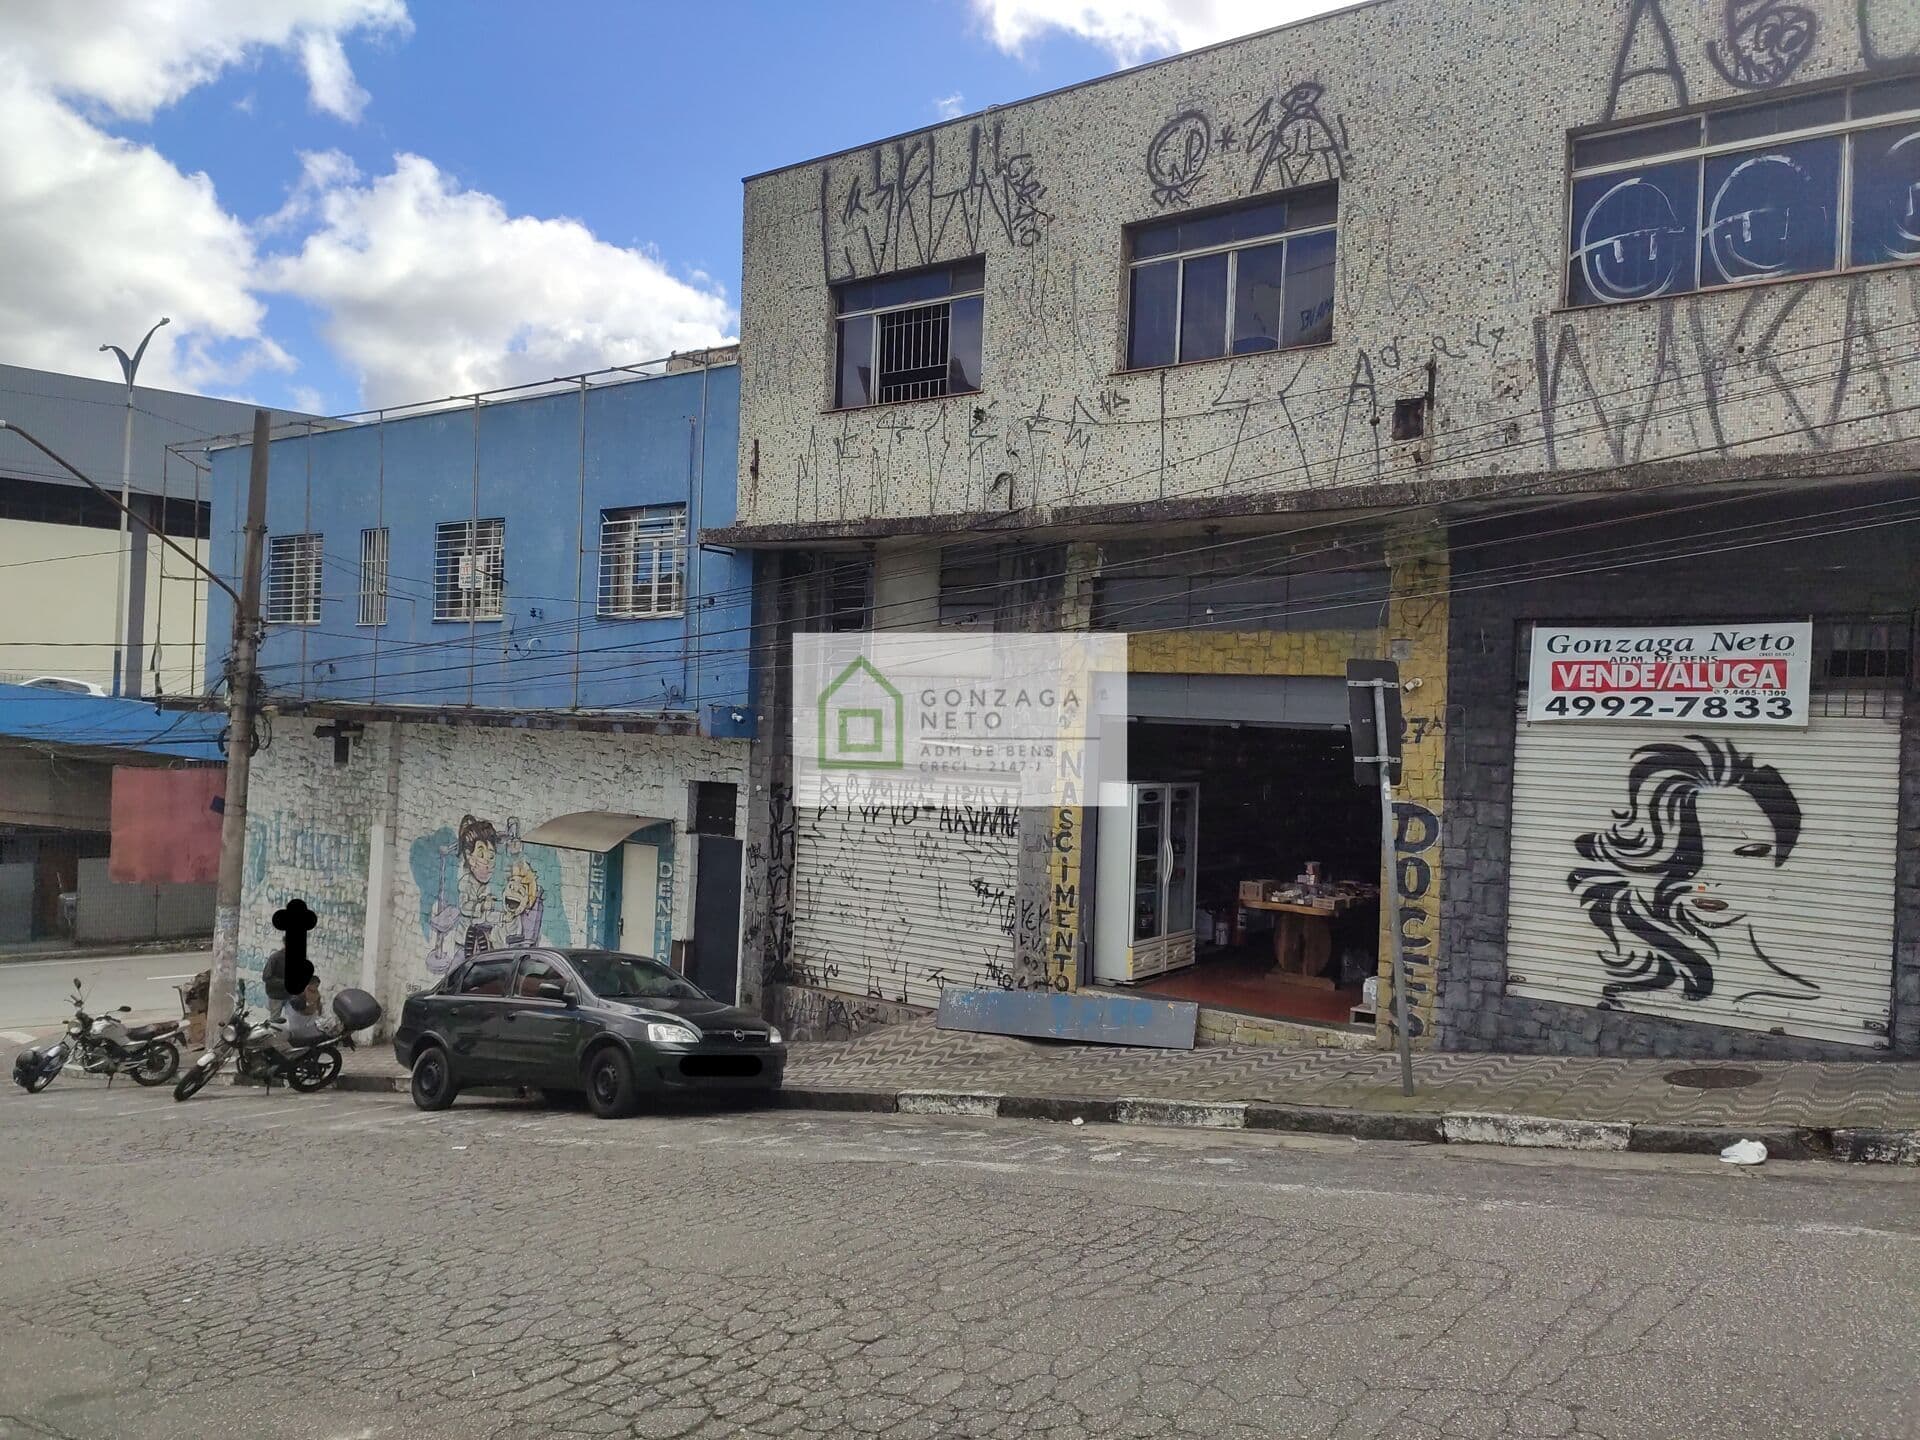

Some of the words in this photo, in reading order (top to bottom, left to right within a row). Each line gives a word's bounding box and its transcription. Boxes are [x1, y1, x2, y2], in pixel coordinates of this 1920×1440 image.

[1546, 634, 1695, 657] Gonzaga
[1710, 631, 1795, 651] Neto
[1654, 655, 1673, 663] DE
[1679, 655, 1720, 663] BENS
[1557, 663, 1782, 690] VENDE/ALUGA
[1545, 695, 1793, 719] 4992-7833
